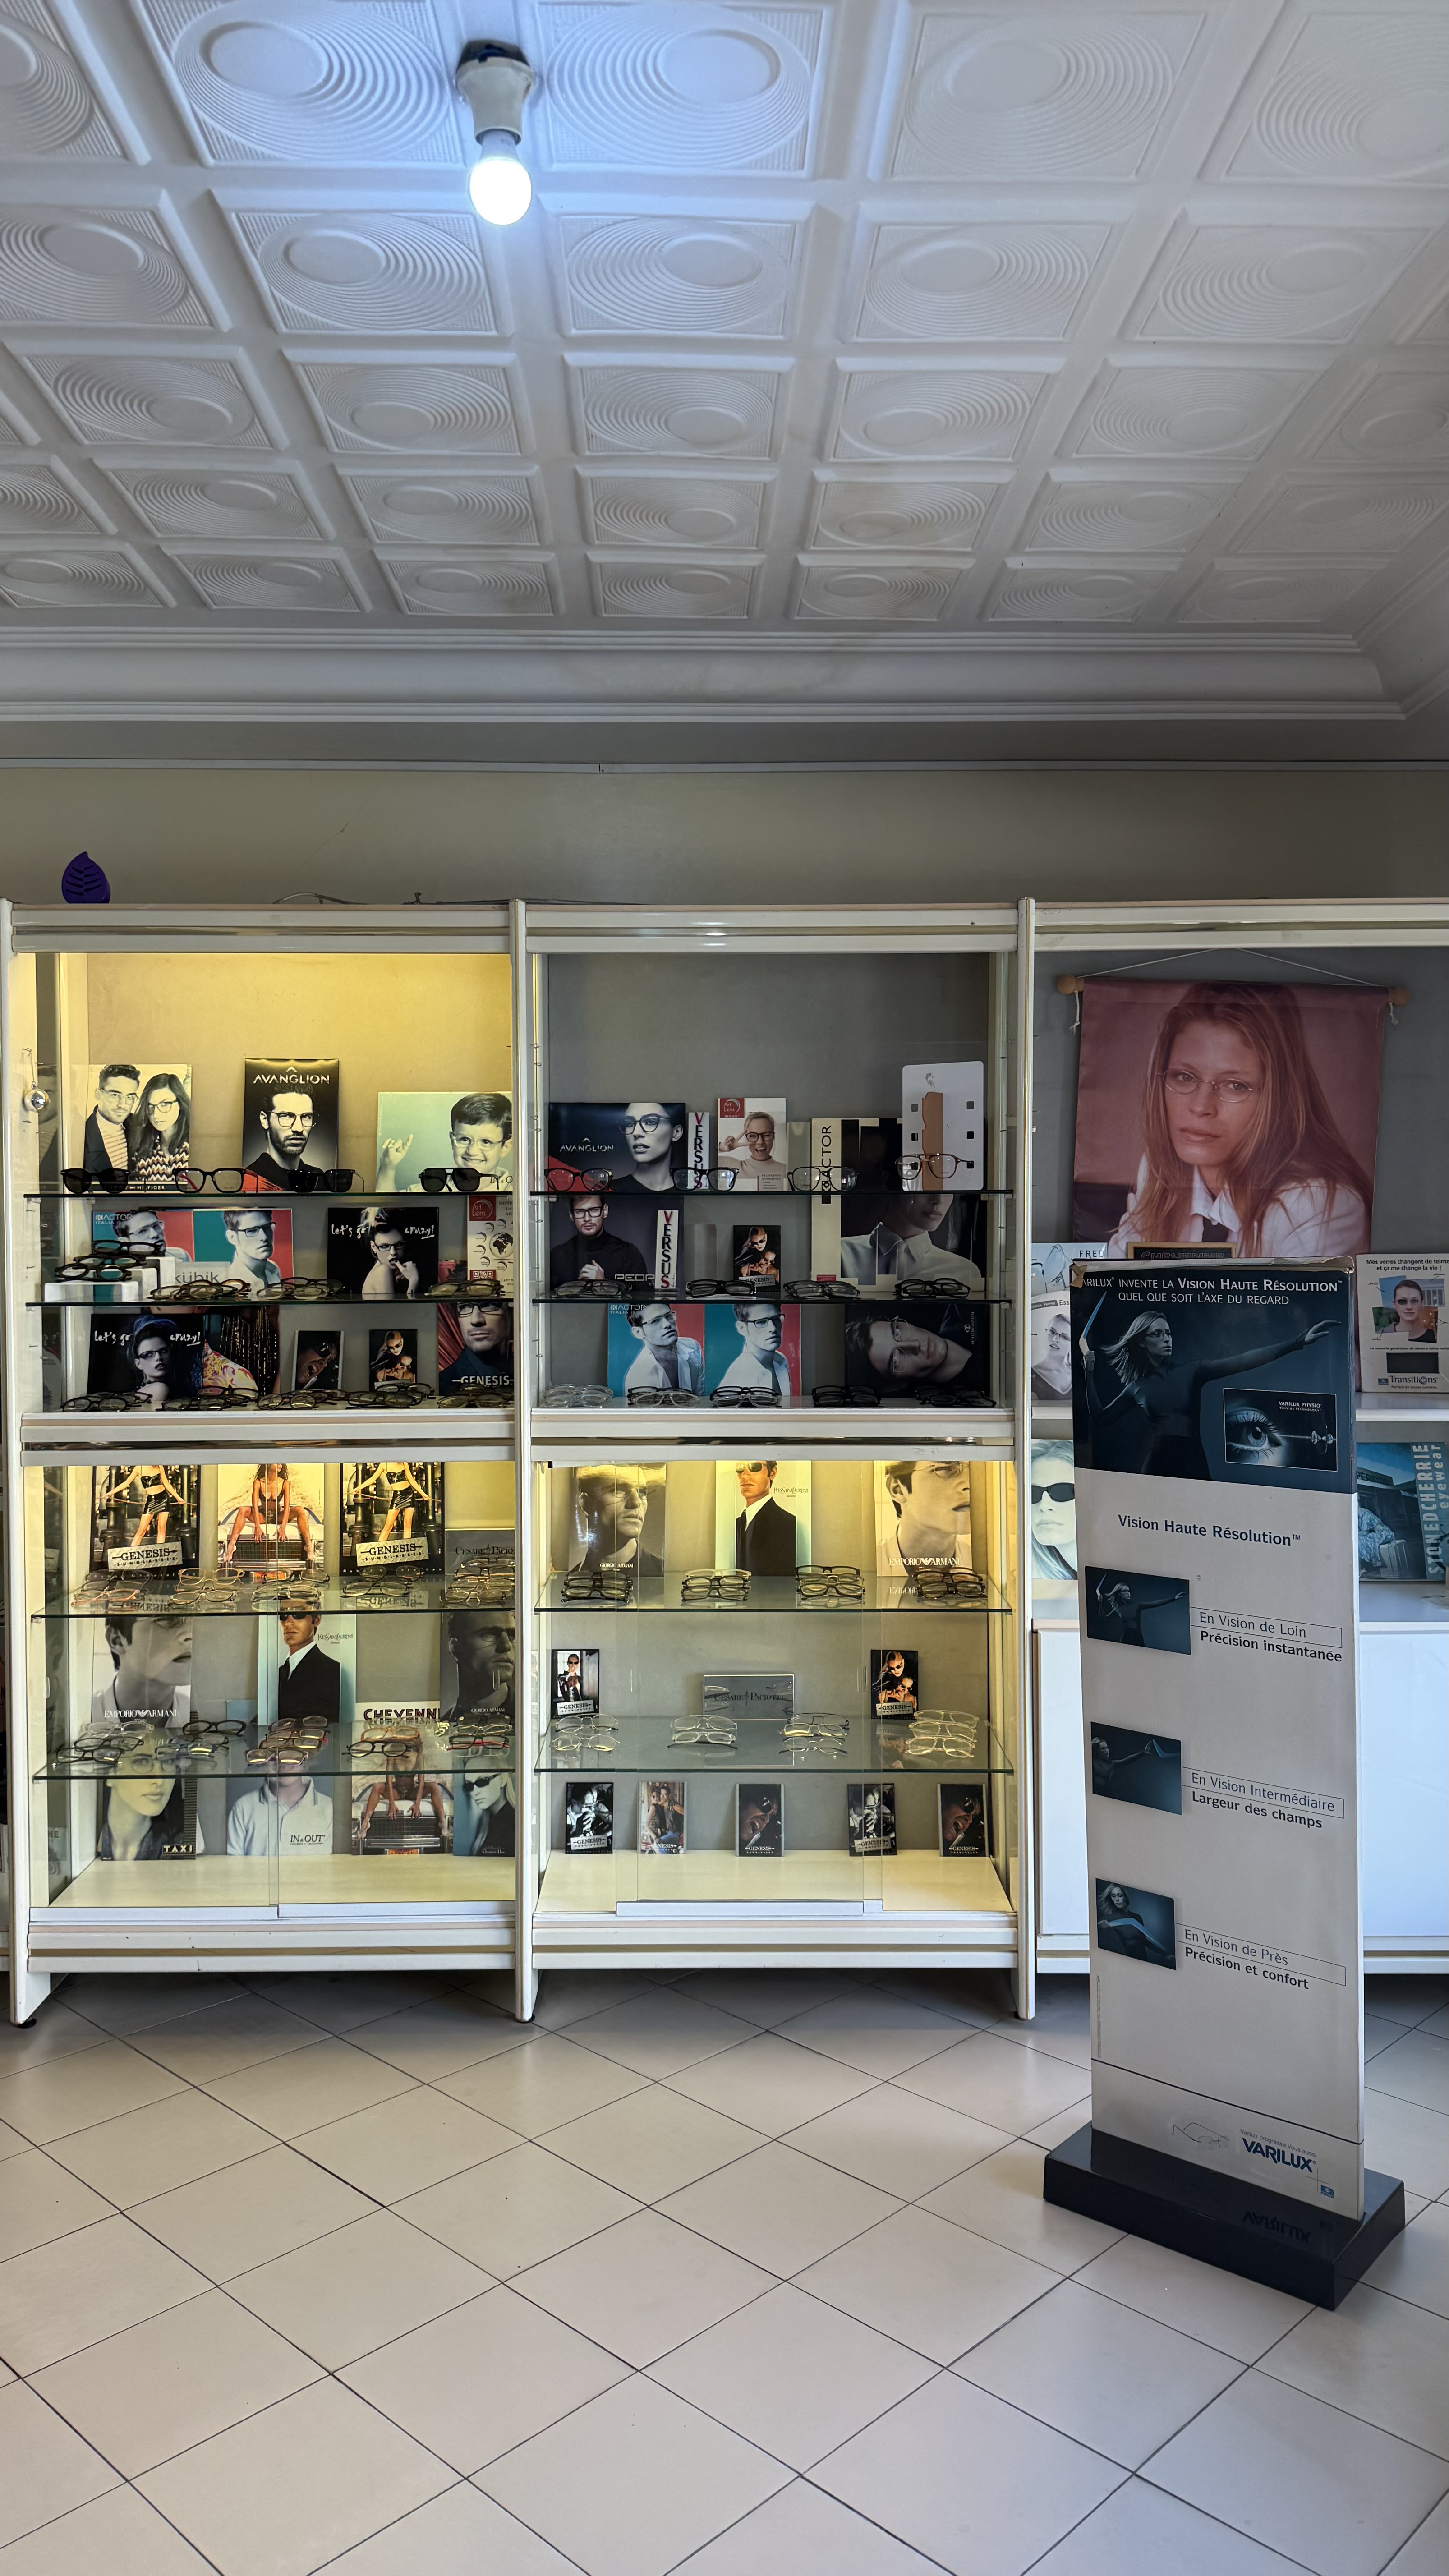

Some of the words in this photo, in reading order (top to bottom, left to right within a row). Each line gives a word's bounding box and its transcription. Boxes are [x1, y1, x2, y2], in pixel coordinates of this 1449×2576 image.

[660, 1210, 673, 1289] VERSUS
[1079, 1250, 1105, 1258] FRED
[1081, 1276, 1115, 1287] ARILUX®
[1119, 1279, 1158, 1289] INVENTE
[1163, 1280, 1174, 1289] LA
[1118, 1292, 1144, 1302] QUEL
[1147, 1292, 1167, 1303] QUE
[1171, 1292, 1193, 1303] SOIT
[1197, 1292, 1224, 1304] L'AXE
[1228, 1294, 1242, 1304] DU
[1247, 1294, 1289, 1305] REGARD
[1431, 1444, 1449, 1509] eyewear
[1118, 1514, 1159, 1531] Vision
[1164, 1519, 1207, 1537] Haute
[121, 1547, 170, 1561] GENESIS
[369, 1543, 416, 1555] GENESIS
[889, 1557, 921, 1567] EMPORIO
[930, 1557, 960, 1567] ARMANI
[1199, 1611, 1214, 1625] En
[1219, 1613, 1255, 1631] Vision
[1260, 1619, 1275, 1633] de
[1280, 1623, 1306, 1638] Loin
[1200, 1630, 1259, 1650] Précision
[1263, 1639, 1343, 1663] instantanée
[104, 1709, 136, 1718] EMPORIO
[146, 1709, 177, 1718] ARMANI
[363, 1707, 440, 1722] CHEYENN
[1191, 1772, 1206, 1786] En
[1210, 1776, 1246, 1794] Vision
[1251, 1784, 1335, 1812] Intermédiaire
[1192, 1790, 1240, 1811] Largeur
[1245, 1803, 1268, 1817] des
[1272, 1808, 1323, 1829] champs
[163, 1845, 193, 1854] TAXI
[1185, 1929, 1199, 1942] En
[1203, 1932, 1237, 1953] Vision
[1242, 1942, 1257, 1958] de
[1261, 1947, 1288, 1966] Près
[1185, 1946, 1241, 1972] Précision
[1246, 1964, 1258, 1976] et
[1262, 1968, 1309, 1990] confort
